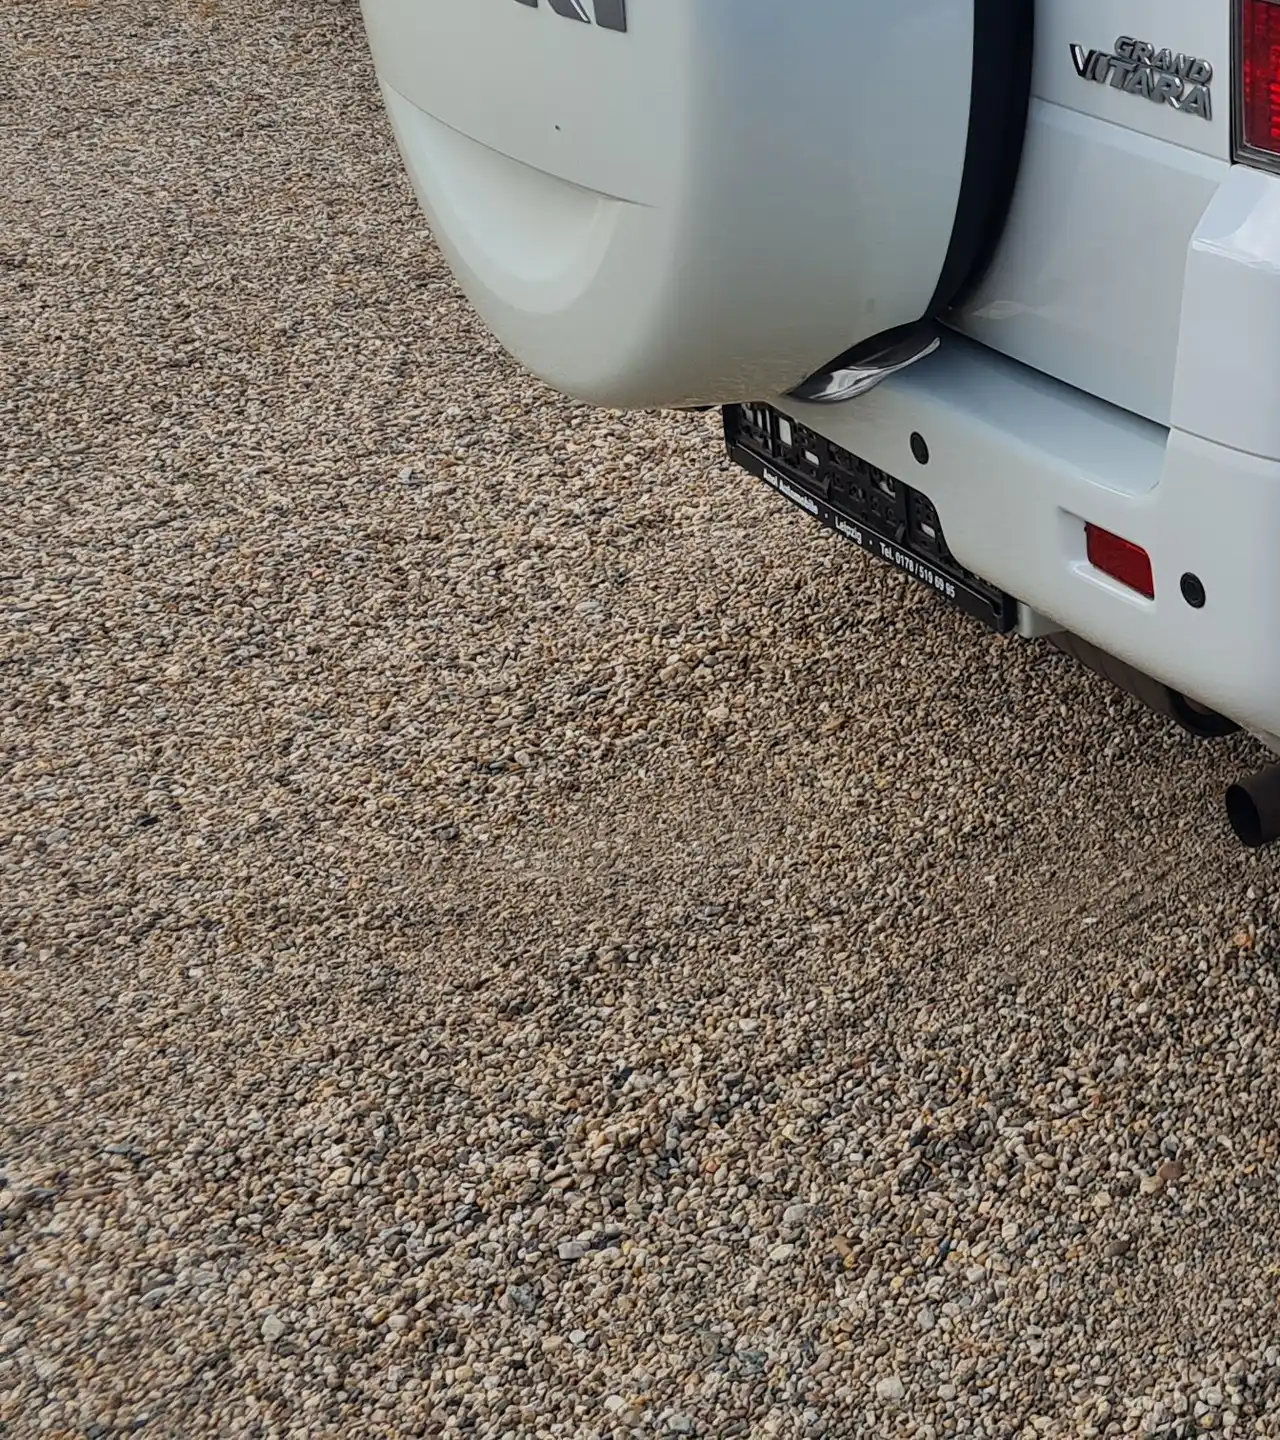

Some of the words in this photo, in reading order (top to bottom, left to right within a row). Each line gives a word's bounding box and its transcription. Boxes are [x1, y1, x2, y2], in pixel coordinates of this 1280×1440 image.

[1069, 43, 1213, 121] VITARA
[1114, 35, 1213, 84] GRAND
[835, 515, 862, 545] Leipzig
[879, 542, 894, 561] Tel.
